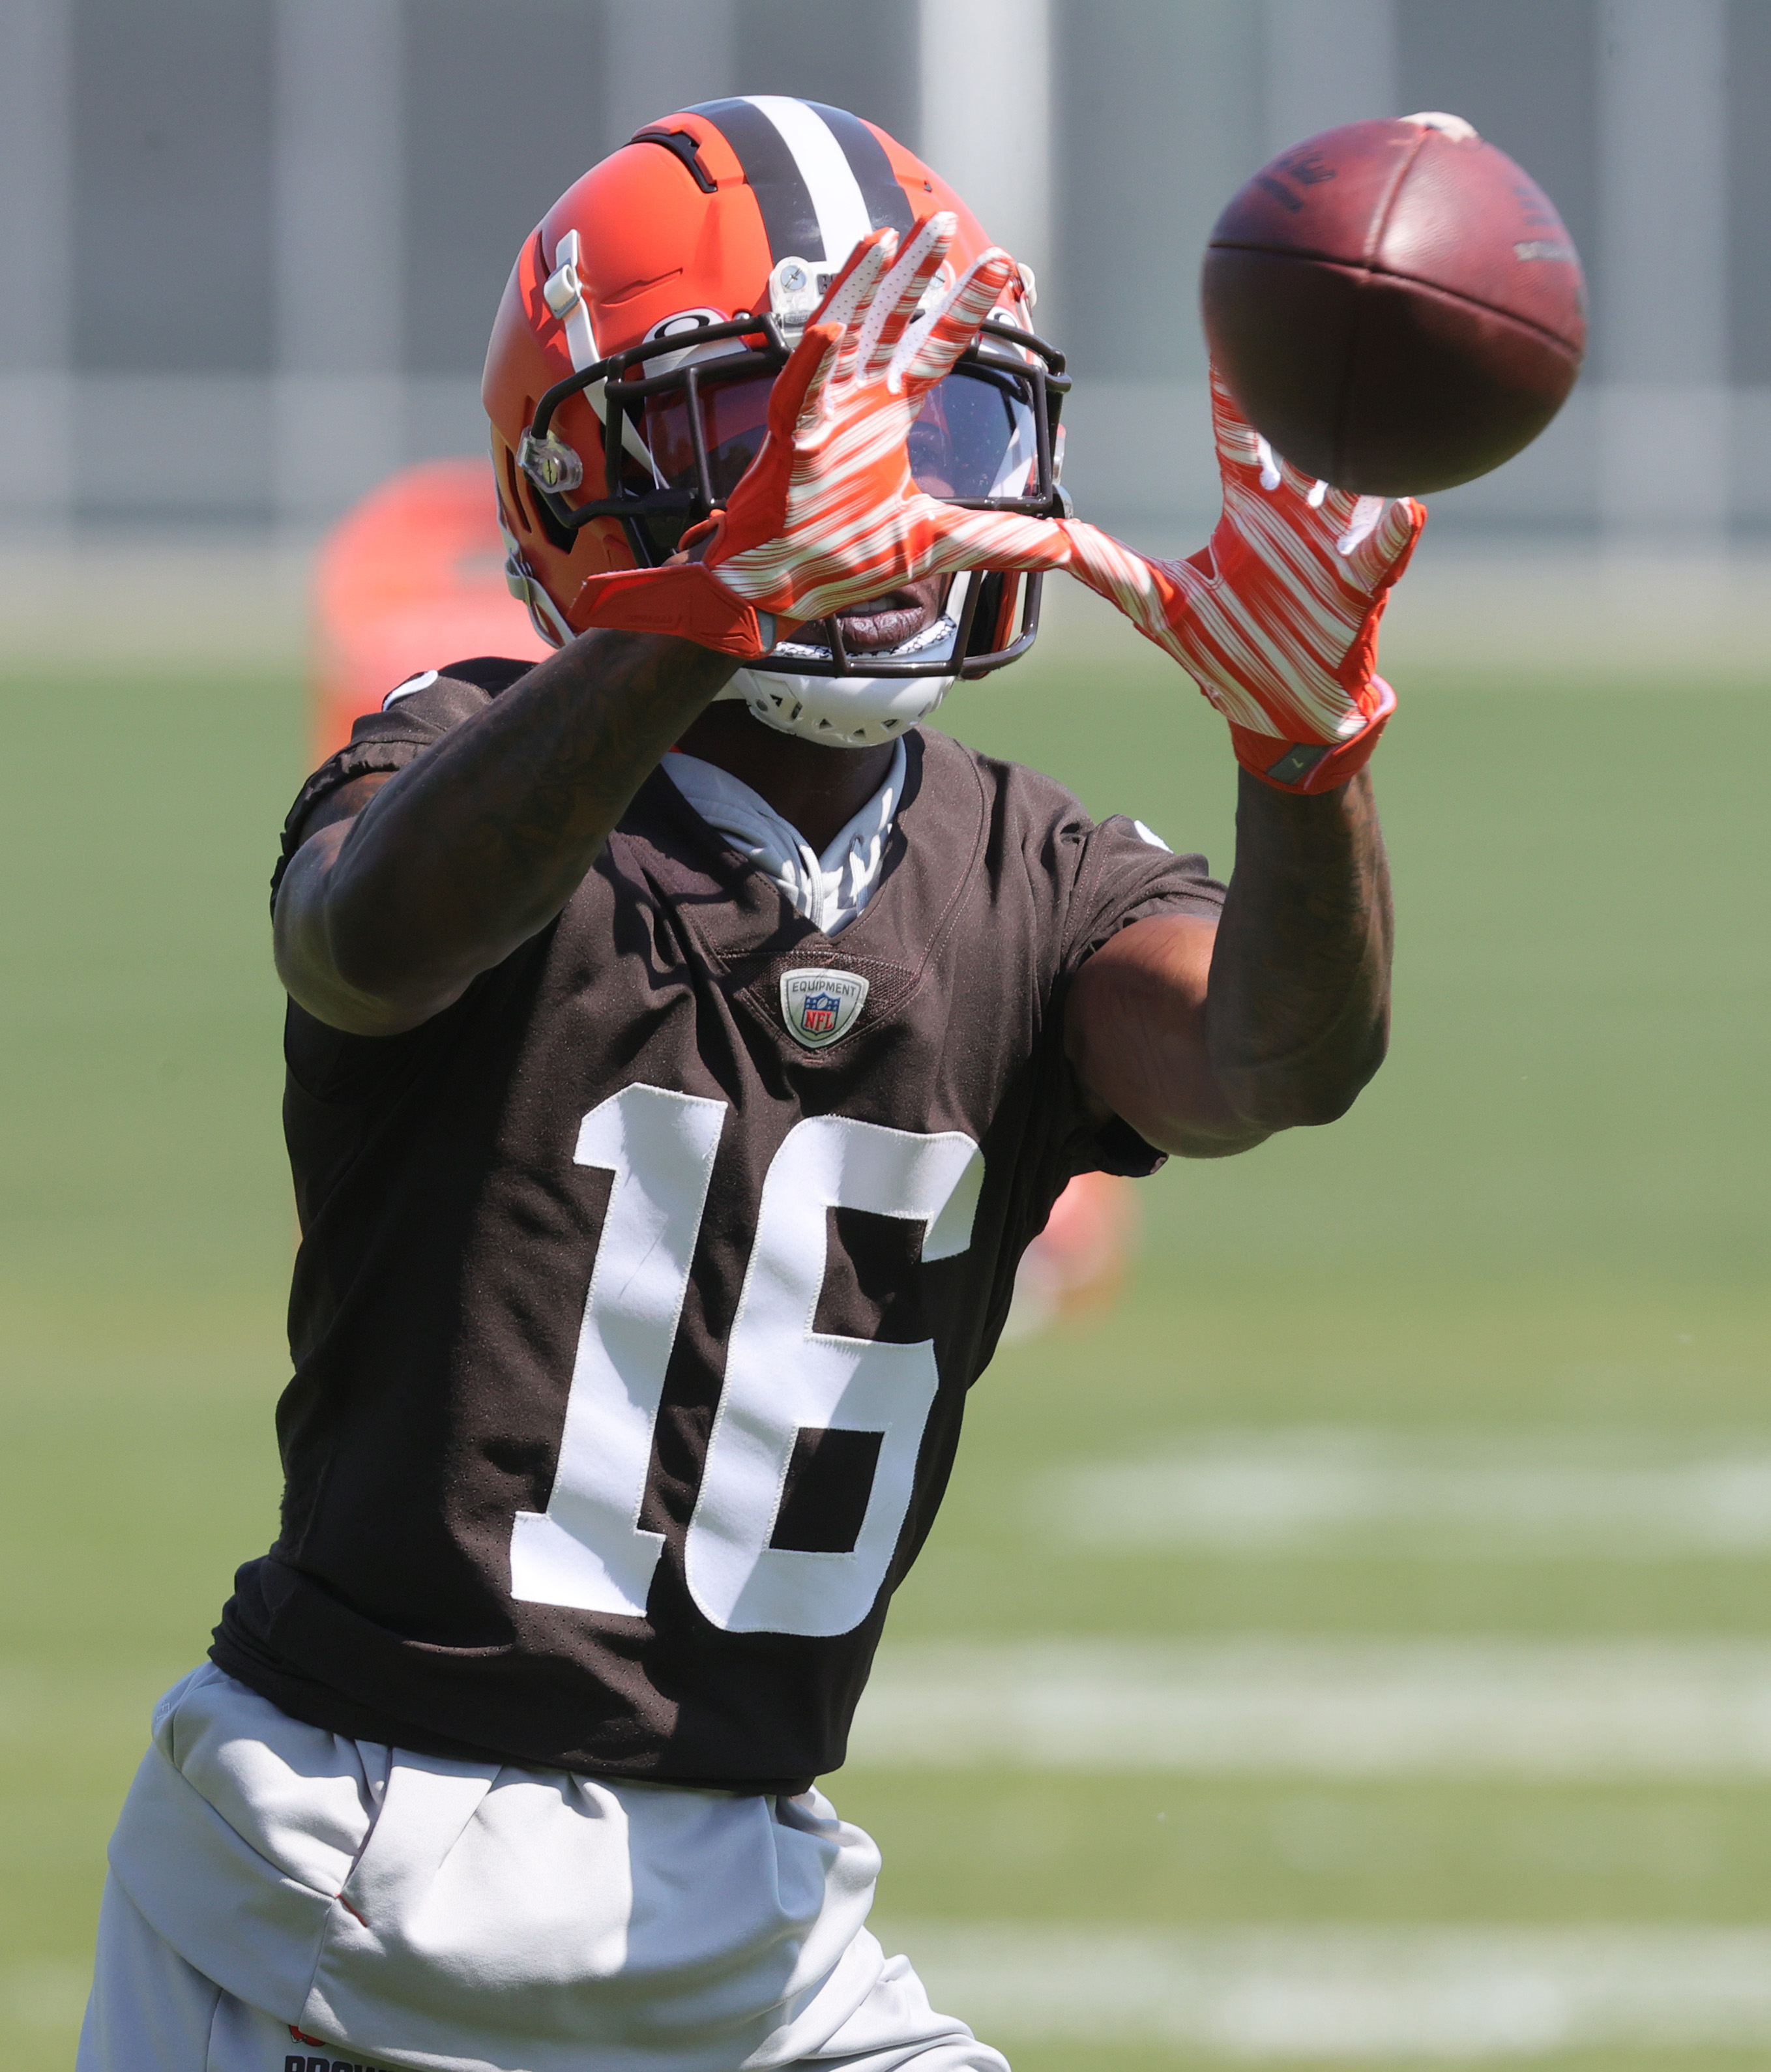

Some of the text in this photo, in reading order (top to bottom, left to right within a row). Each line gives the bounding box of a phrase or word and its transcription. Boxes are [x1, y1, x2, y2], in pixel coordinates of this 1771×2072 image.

[792, 981, 857, 998] EQUIPMENT
[804, 1010, 834, 1031] NFL
[510, 1082, 986, 1637] 16
